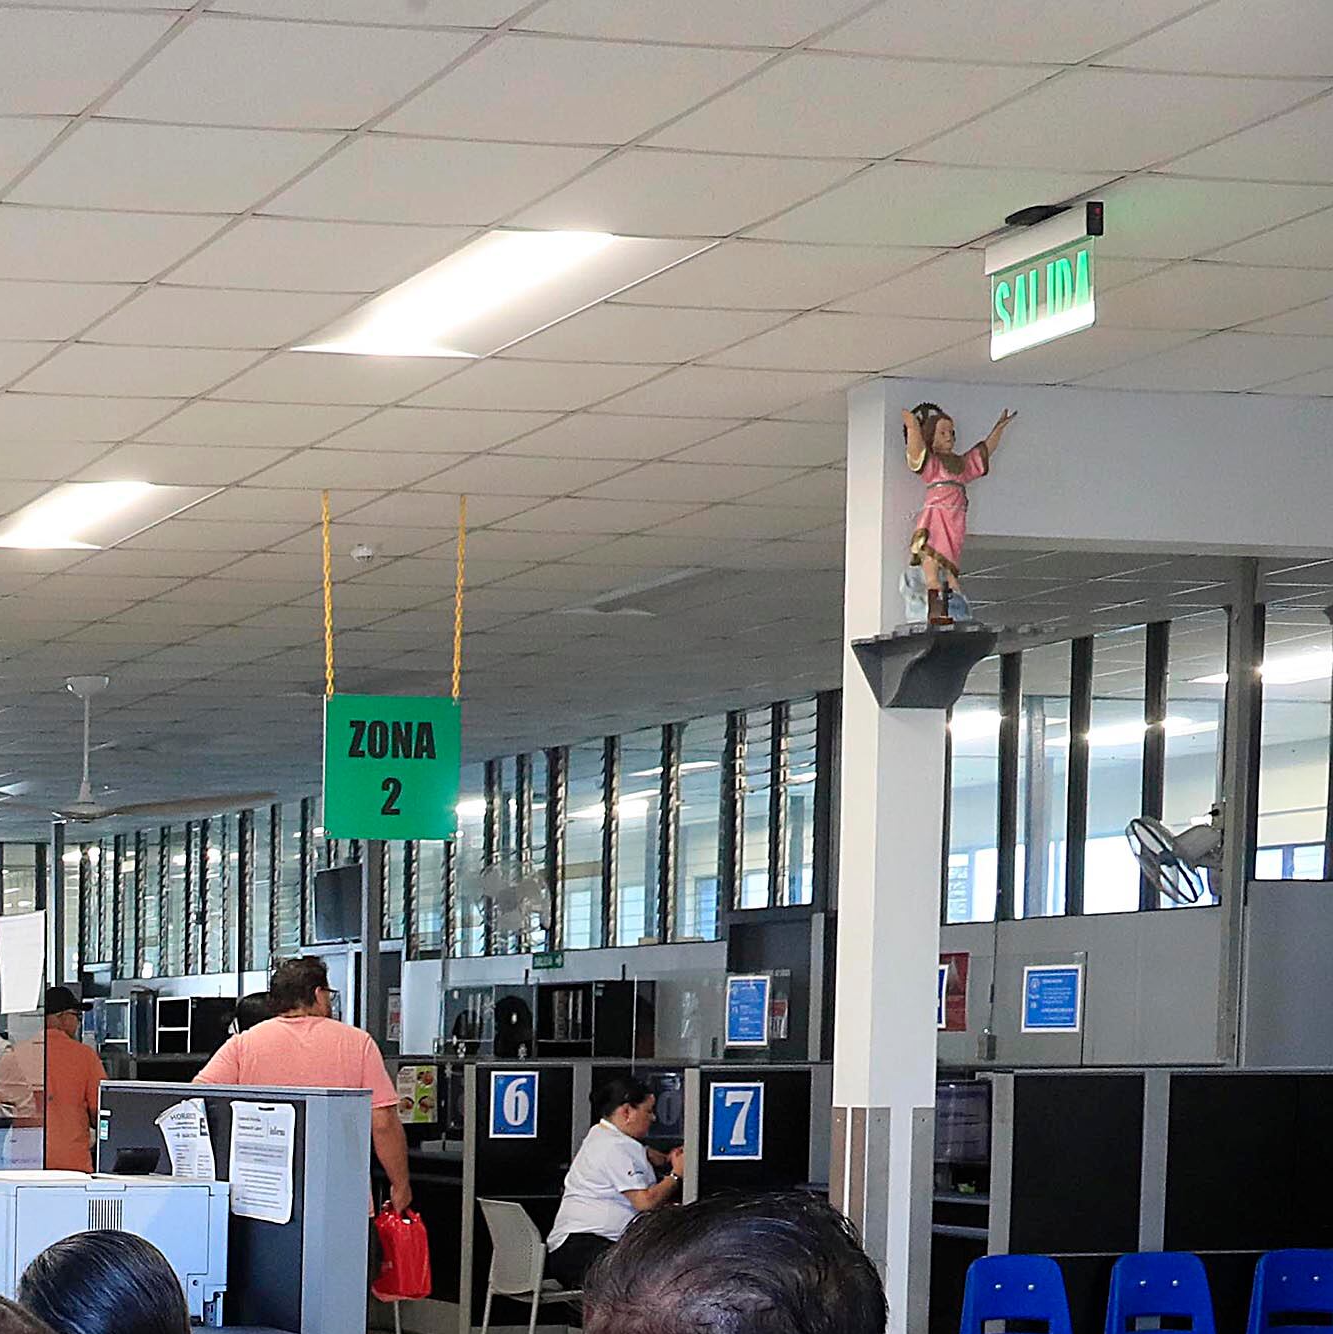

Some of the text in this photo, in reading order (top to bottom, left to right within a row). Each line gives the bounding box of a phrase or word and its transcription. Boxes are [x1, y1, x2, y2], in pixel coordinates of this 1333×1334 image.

[348, 720, 437, 760] ZONA
[380, 777, 403, 816] 2
[502, 1077, 530, 1126] 6
[724, 1090, 754, 1146] 7
